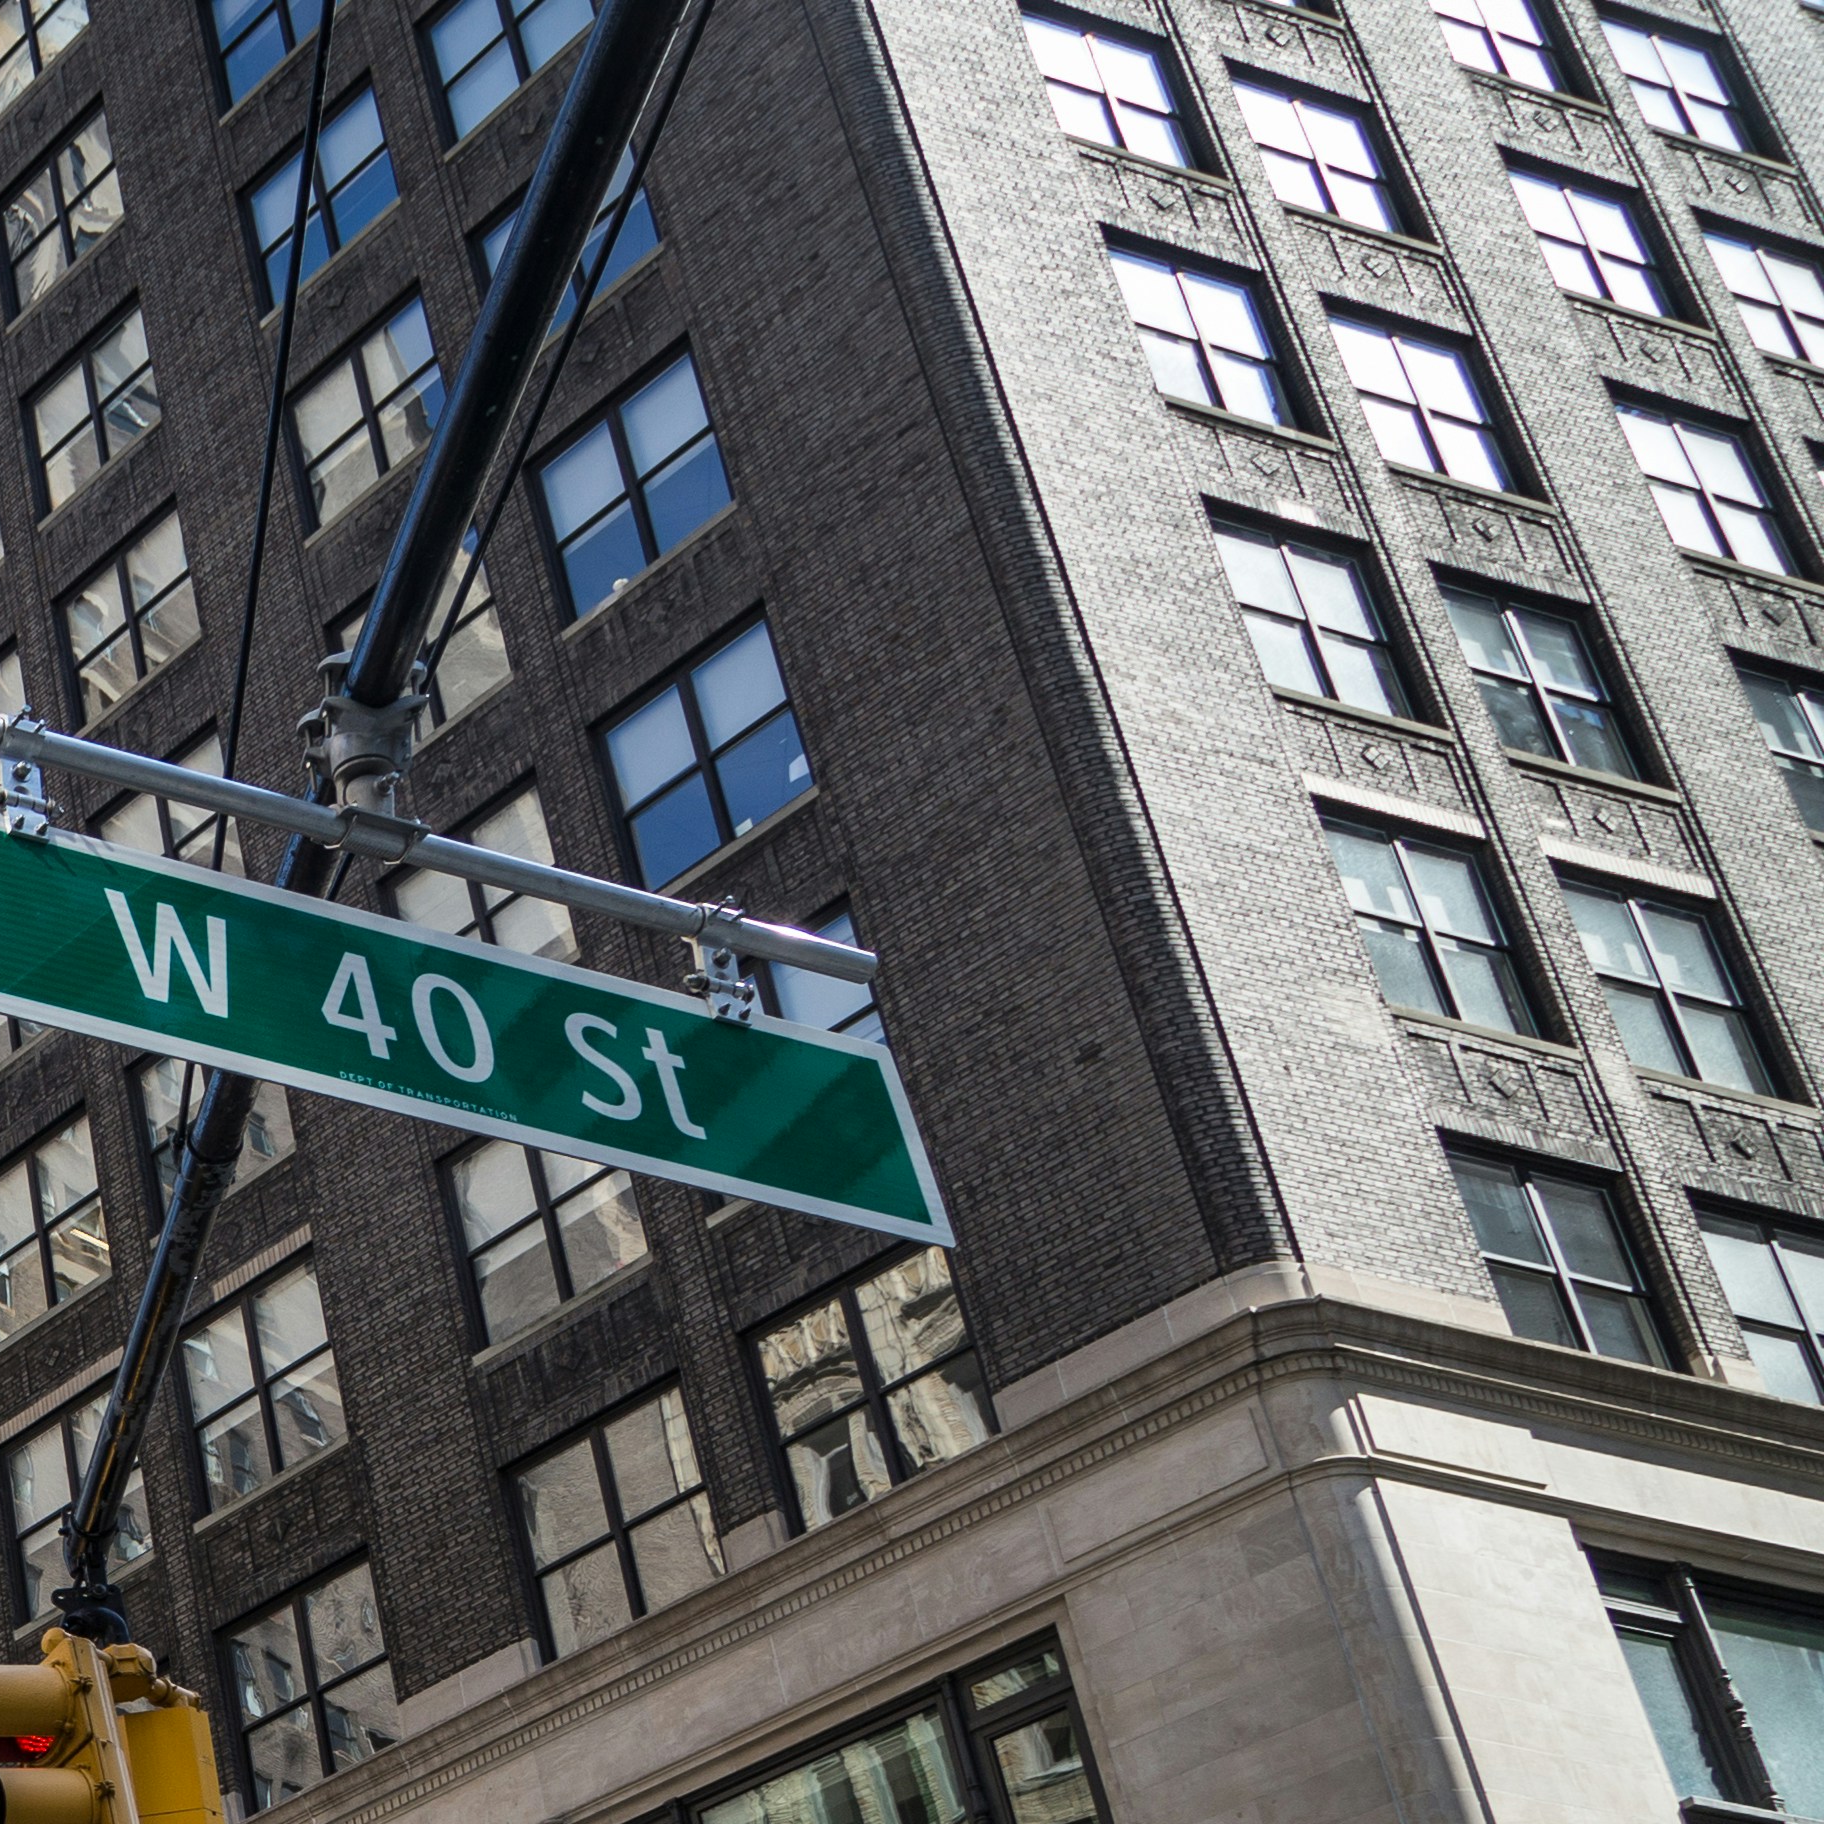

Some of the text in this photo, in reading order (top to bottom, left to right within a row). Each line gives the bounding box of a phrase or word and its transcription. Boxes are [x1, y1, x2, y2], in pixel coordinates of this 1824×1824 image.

[104, 887, 709, 1141] W 40 St
[339, 1071, 518, 1123] DEPT OF TRANSPORTATION
